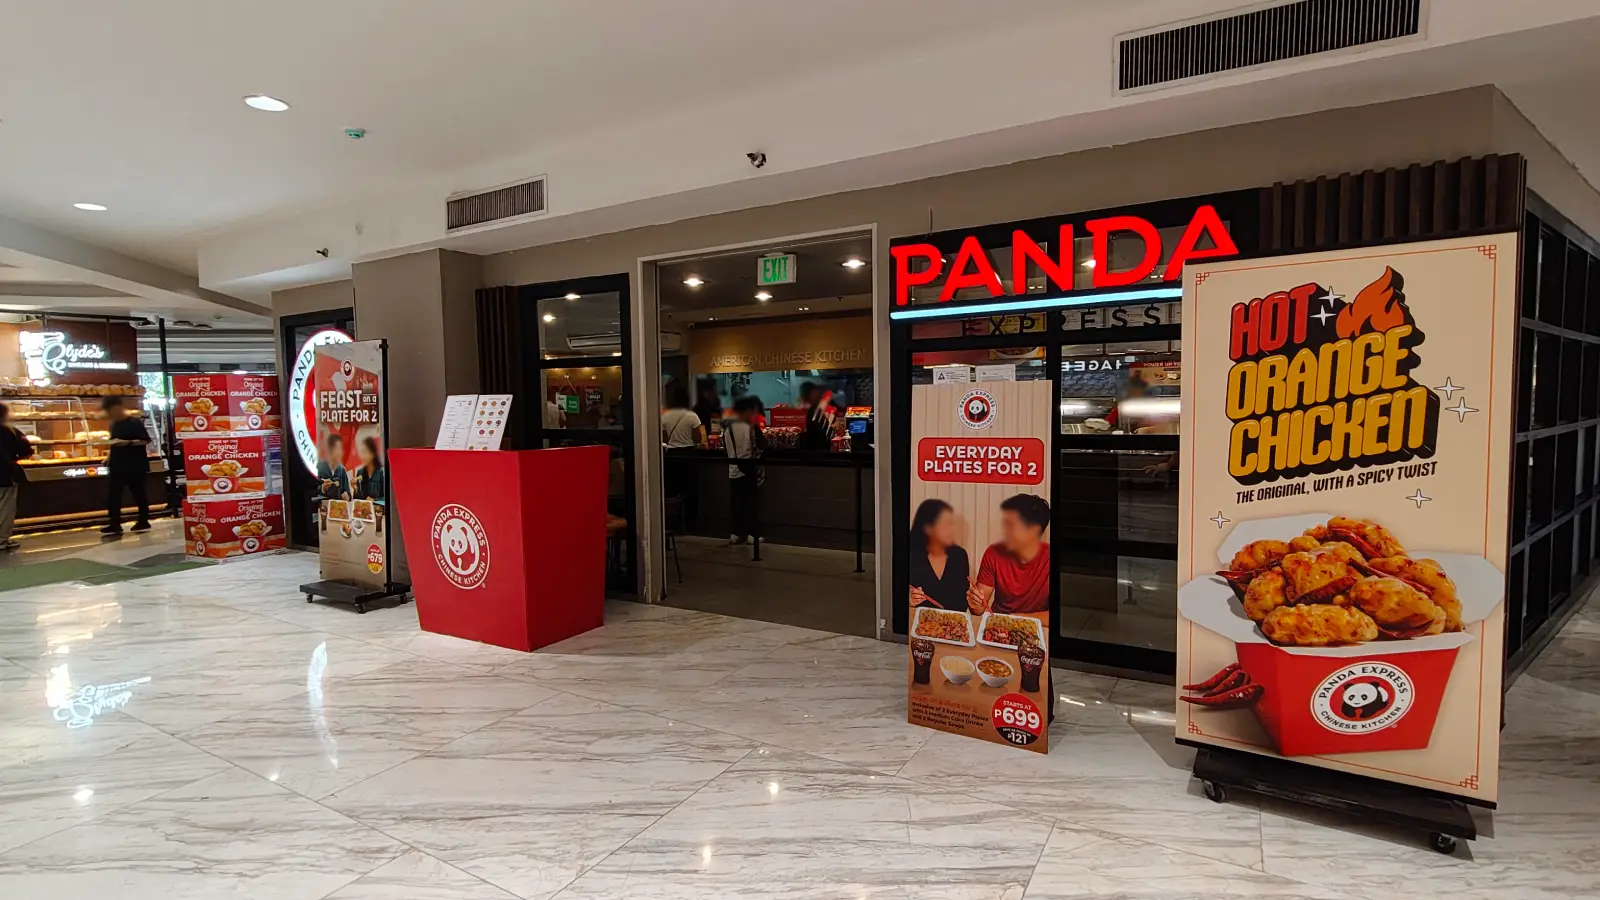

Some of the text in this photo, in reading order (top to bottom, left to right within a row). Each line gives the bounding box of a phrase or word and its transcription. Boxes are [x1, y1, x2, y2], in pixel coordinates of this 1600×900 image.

[890, 205, 1239, 306] PANDA
[763, 257, 788, 283] EXIT
[1229, 283, 1318, 360] HOT
[709, 348, 866, 368] AMERICAN CHINESE KITCHEN
[1225, 325, 1413, 420] ORANGE
[320, 390, 362, 409] FEAST
[321, 410, 377, 423] PLATE FOR 2
[1228, 386, 1429, 477] CHICKEN
[188, 453, 222, 461] ORANGE
[208, 443, 238, 454] Original
[936, 445, 1022, 459] EVERYDAY
[924, 460, 1037, 476] PLATES FOR 2
[1236, 461, 1438, 504] THE ORIGINAL, WITH A SPICY TWIST
[220, 510, 281, 524] ORANGE CHICKEN
[433, 507, 486, 547] PANDA EXPRESS
[438, 553, 486, 585] CHINESE KITCHEN
[1319, 666, 1408, 698] PANDA EXPRESS
[1003, 700, 1024, 709] STARTS
[1321, 706, 1401, 729] CHINESE KITCHEN
